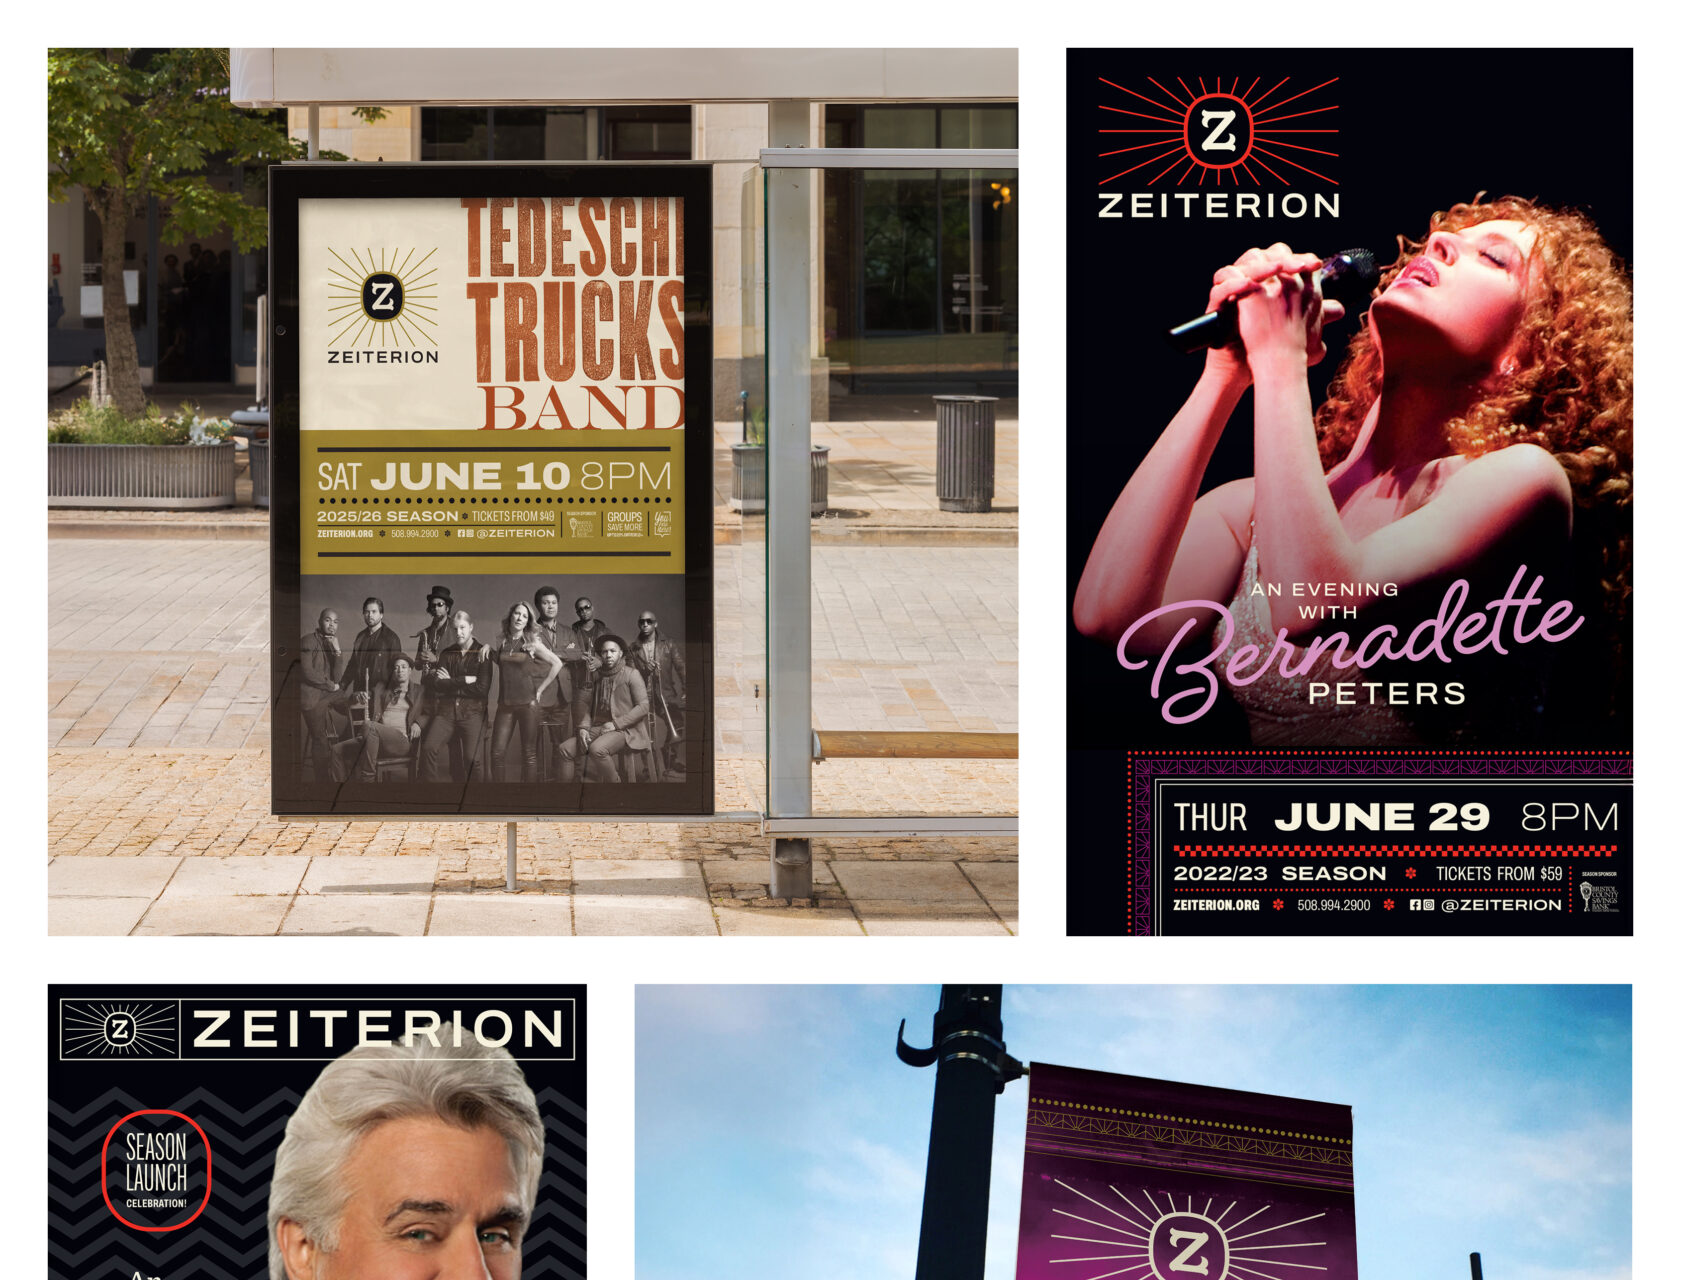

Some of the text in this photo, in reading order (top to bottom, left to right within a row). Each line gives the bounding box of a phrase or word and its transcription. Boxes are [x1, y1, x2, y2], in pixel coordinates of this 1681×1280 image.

[1201, 109, 1236, 152] Z
[1099, 193, 1339, 218] ZEITERION
[371, 282, 394, 311] Z
[466, 280, 685, 382] TRUCKS
[327, 351, 438, 363] ZEITERION
[477, 385, 685, 430] BAND
[318, 462, 671, 490] SAT JUNE 10 8PM
[317, 511, 381, 522] 2025/26
[387, 511, 458, 522] SEASON
[472, 511, 510, 521] TICKETS
[512, 511, 538, 521] FROM
[540, 510, 554, 521] $49
[608, 512, 642, 522] GROUPS
[608, 523, 642, 531] SAVE MORE
[318, 530, 373, 538] ZEITERION.ORG
[477, 530, 554, 539] @ZEITERION
[1251, 582, 1398, 597] AN EVENING
[1299, 605, 1357, 619] WITH
[1116, 564, 1585, 724] Bernadette
[1308, 682, 1465, 705] PETERS
[1174, 803, 1617, 831] THUR JUNE 29 8PM
[1174, 866, 1562, 881] 2022/23 SEASON TICKETS FROM $59
[1174, 899, 1561, 913] ZEITERION.ORG 508.994.2900 @ZEITERION
[194, 1010, 561, 1047] ZEITERION
[126, 1133, 186, 1161] SEASON
[126, 1164, 186, 1192] LAUNCH
[126, 1199, 187, 1208] CELEBRATION!
